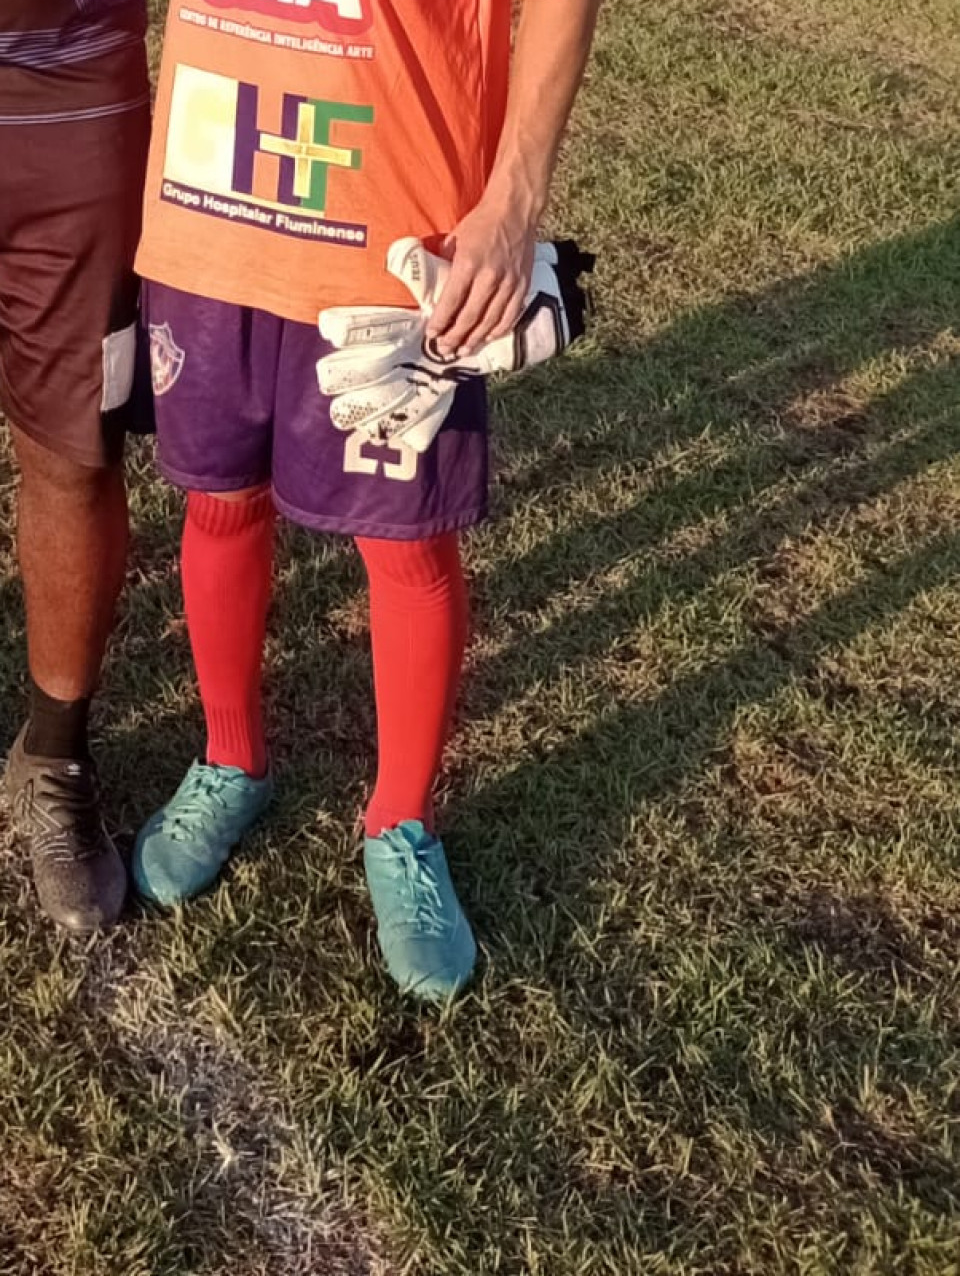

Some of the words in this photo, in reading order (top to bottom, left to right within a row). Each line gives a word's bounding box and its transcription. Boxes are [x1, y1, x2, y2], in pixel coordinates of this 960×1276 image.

[163, 183, 200, 206] Grupo
[203, 194, 273, 225] Hospitalar
[276, 214, 365, 242] Fluminense
